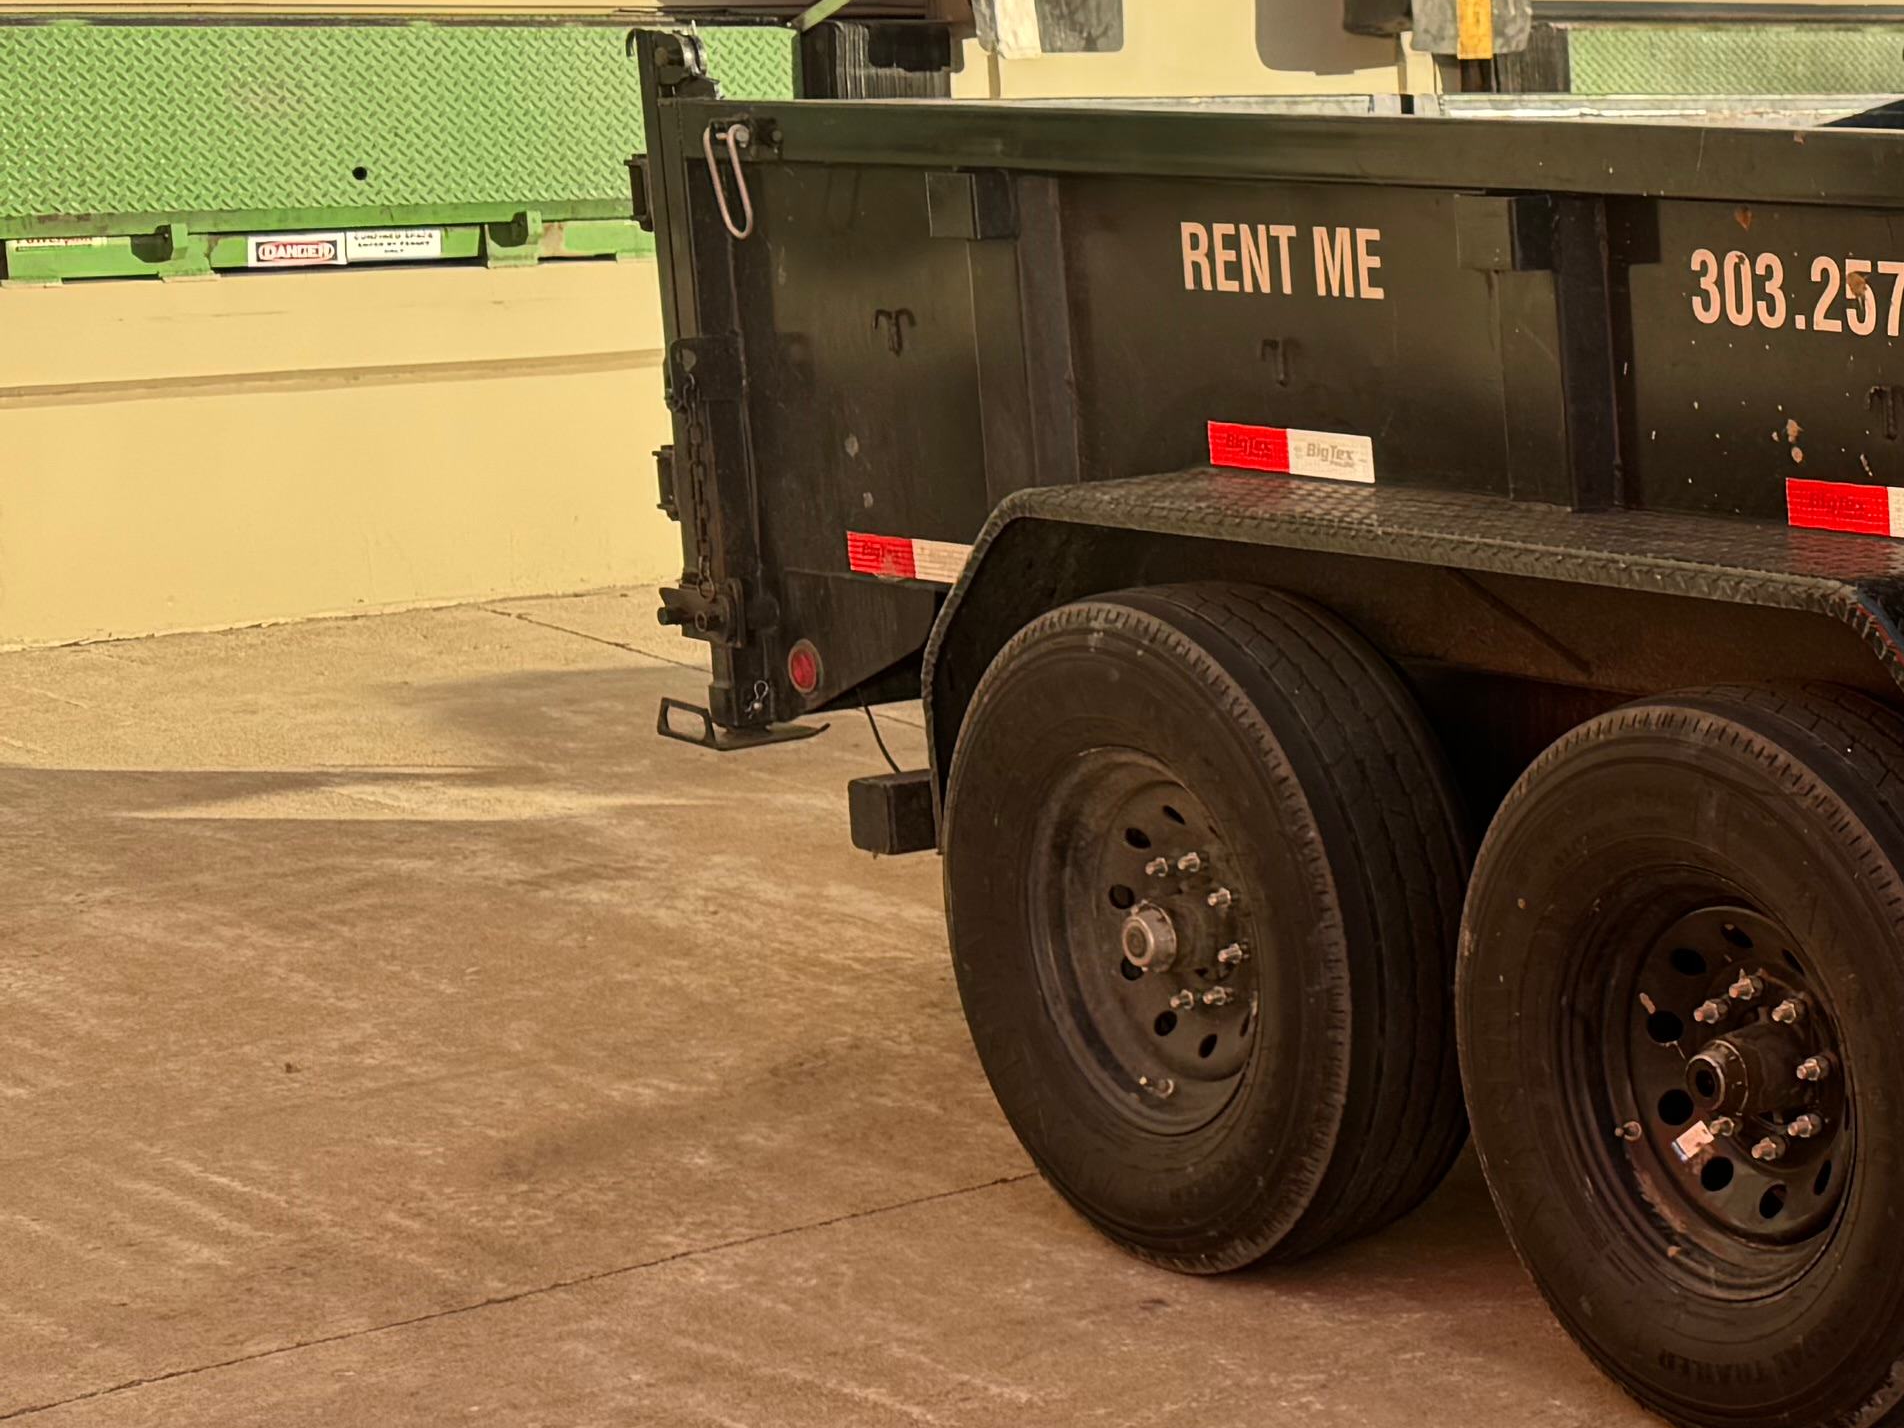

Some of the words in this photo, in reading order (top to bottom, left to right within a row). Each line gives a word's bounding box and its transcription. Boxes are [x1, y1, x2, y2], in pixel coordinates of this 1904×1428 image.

[262, 242, 332, 260] DANGER
[1180, 220, 1298, 294] RENT
[1312, 226, 1385, 301] ME
[1306, 443, 1354, 461] BigTex
